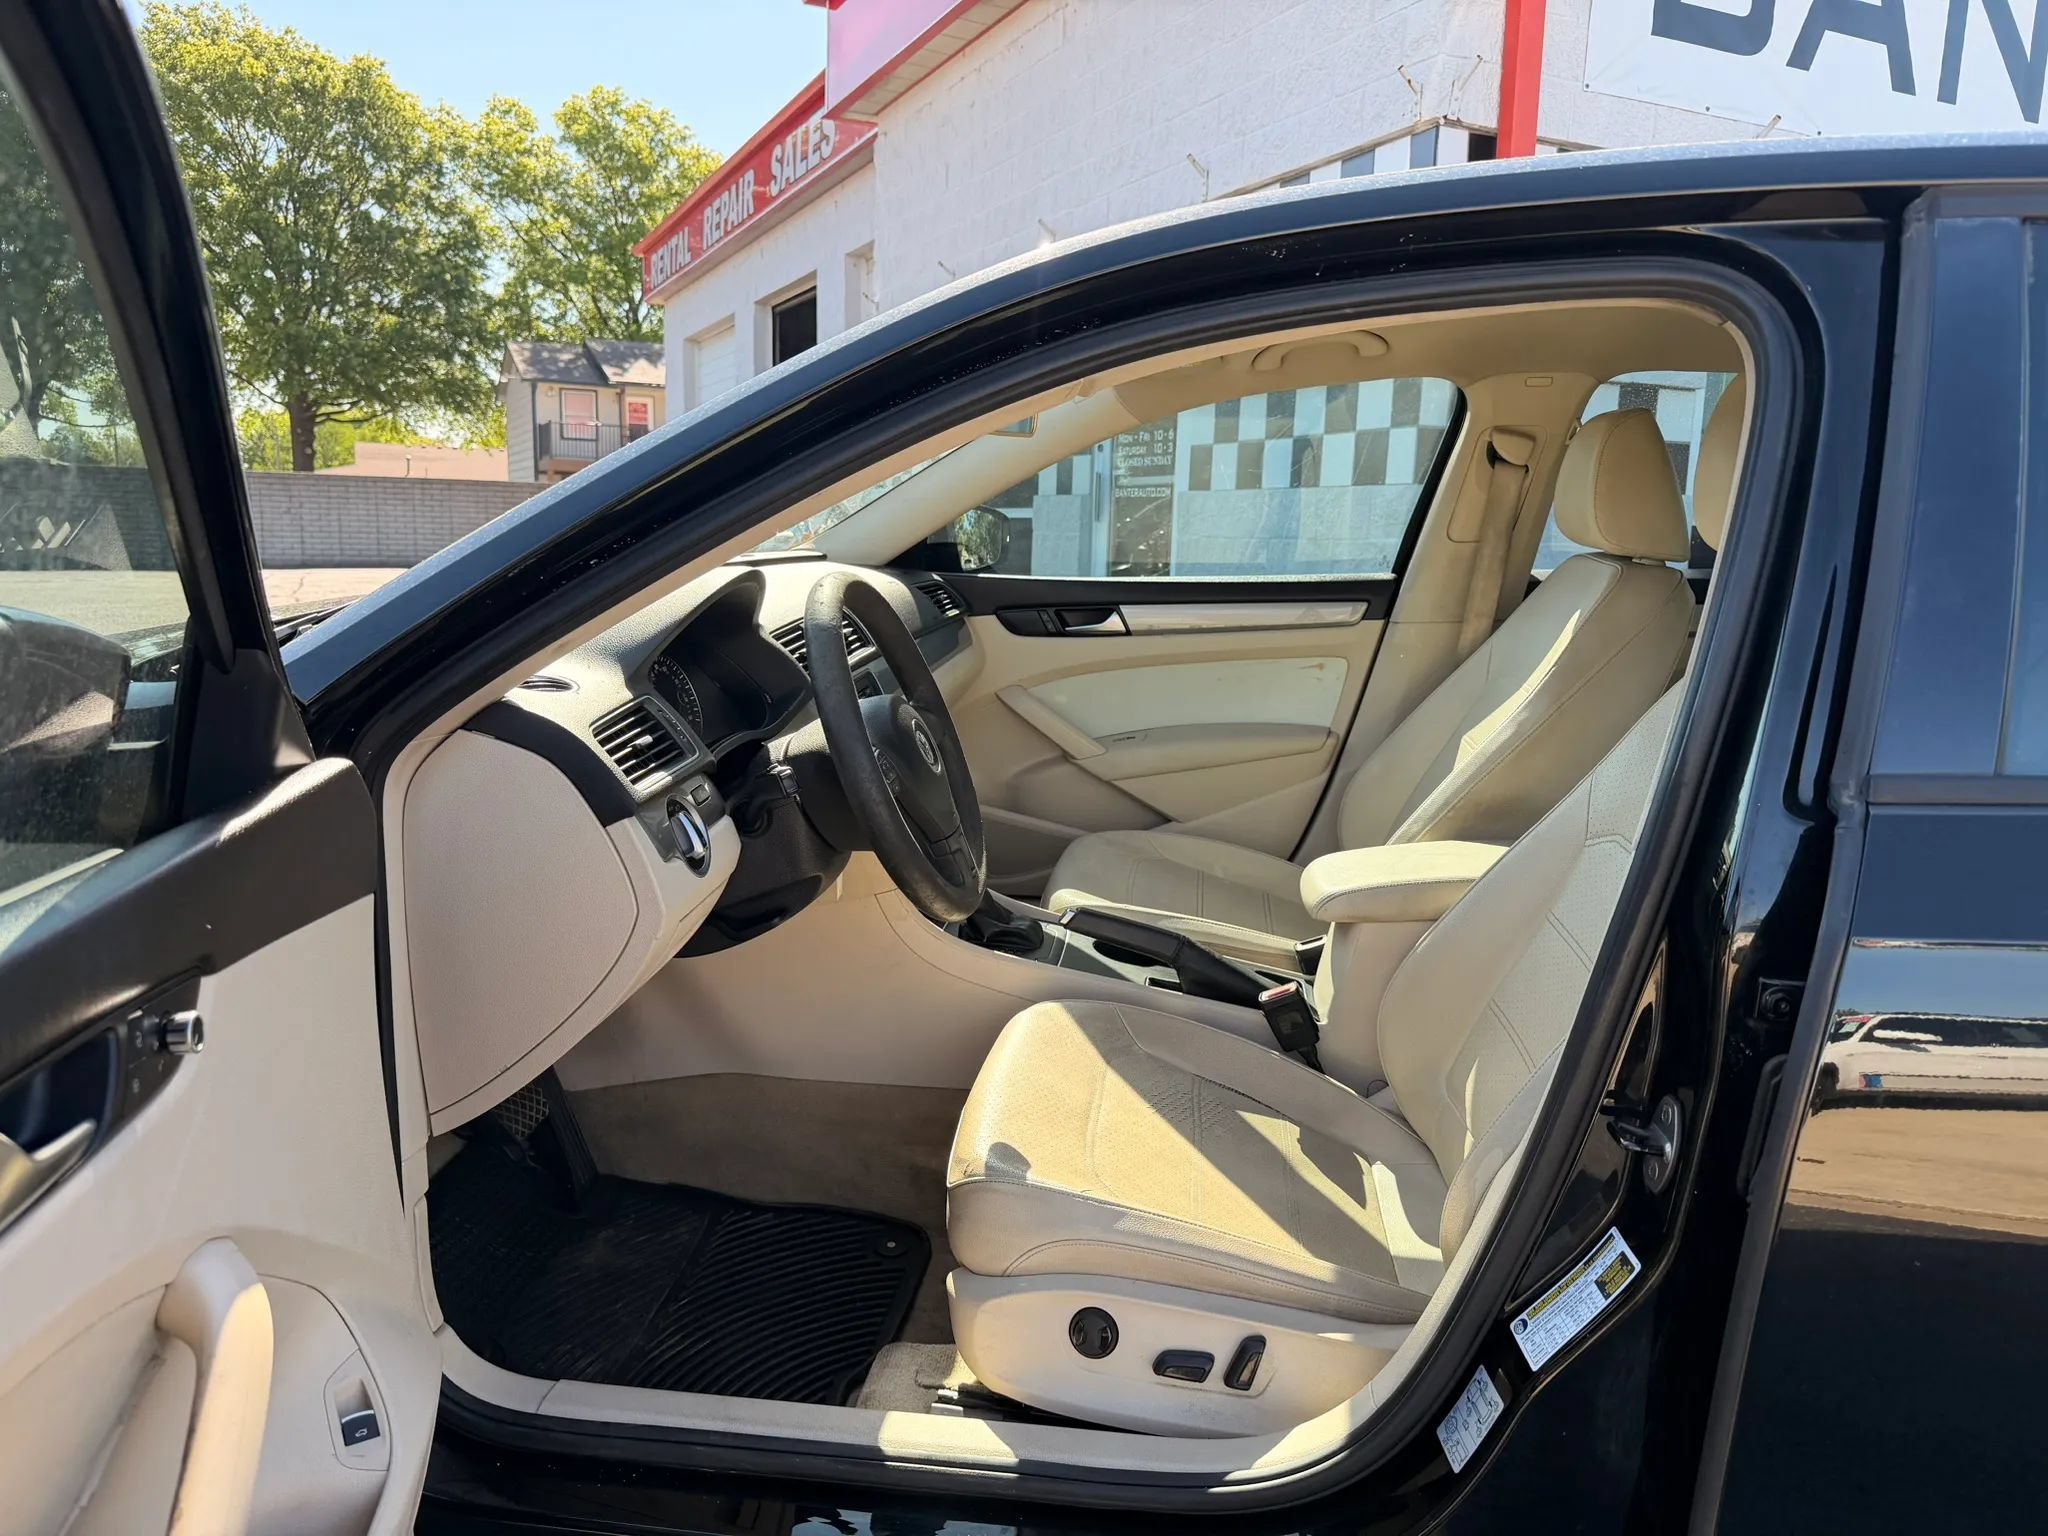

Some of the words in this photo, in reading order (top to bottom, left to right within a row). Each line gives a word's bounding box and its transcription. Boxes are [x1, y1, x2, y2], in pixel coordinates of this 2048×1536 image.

[1651, 0, 2048, 123] AN
[650, 227, 692, 289] RENTAL
[702, 169, 755, 250] REPAIR
[769, 106, 836, 197] SALES
